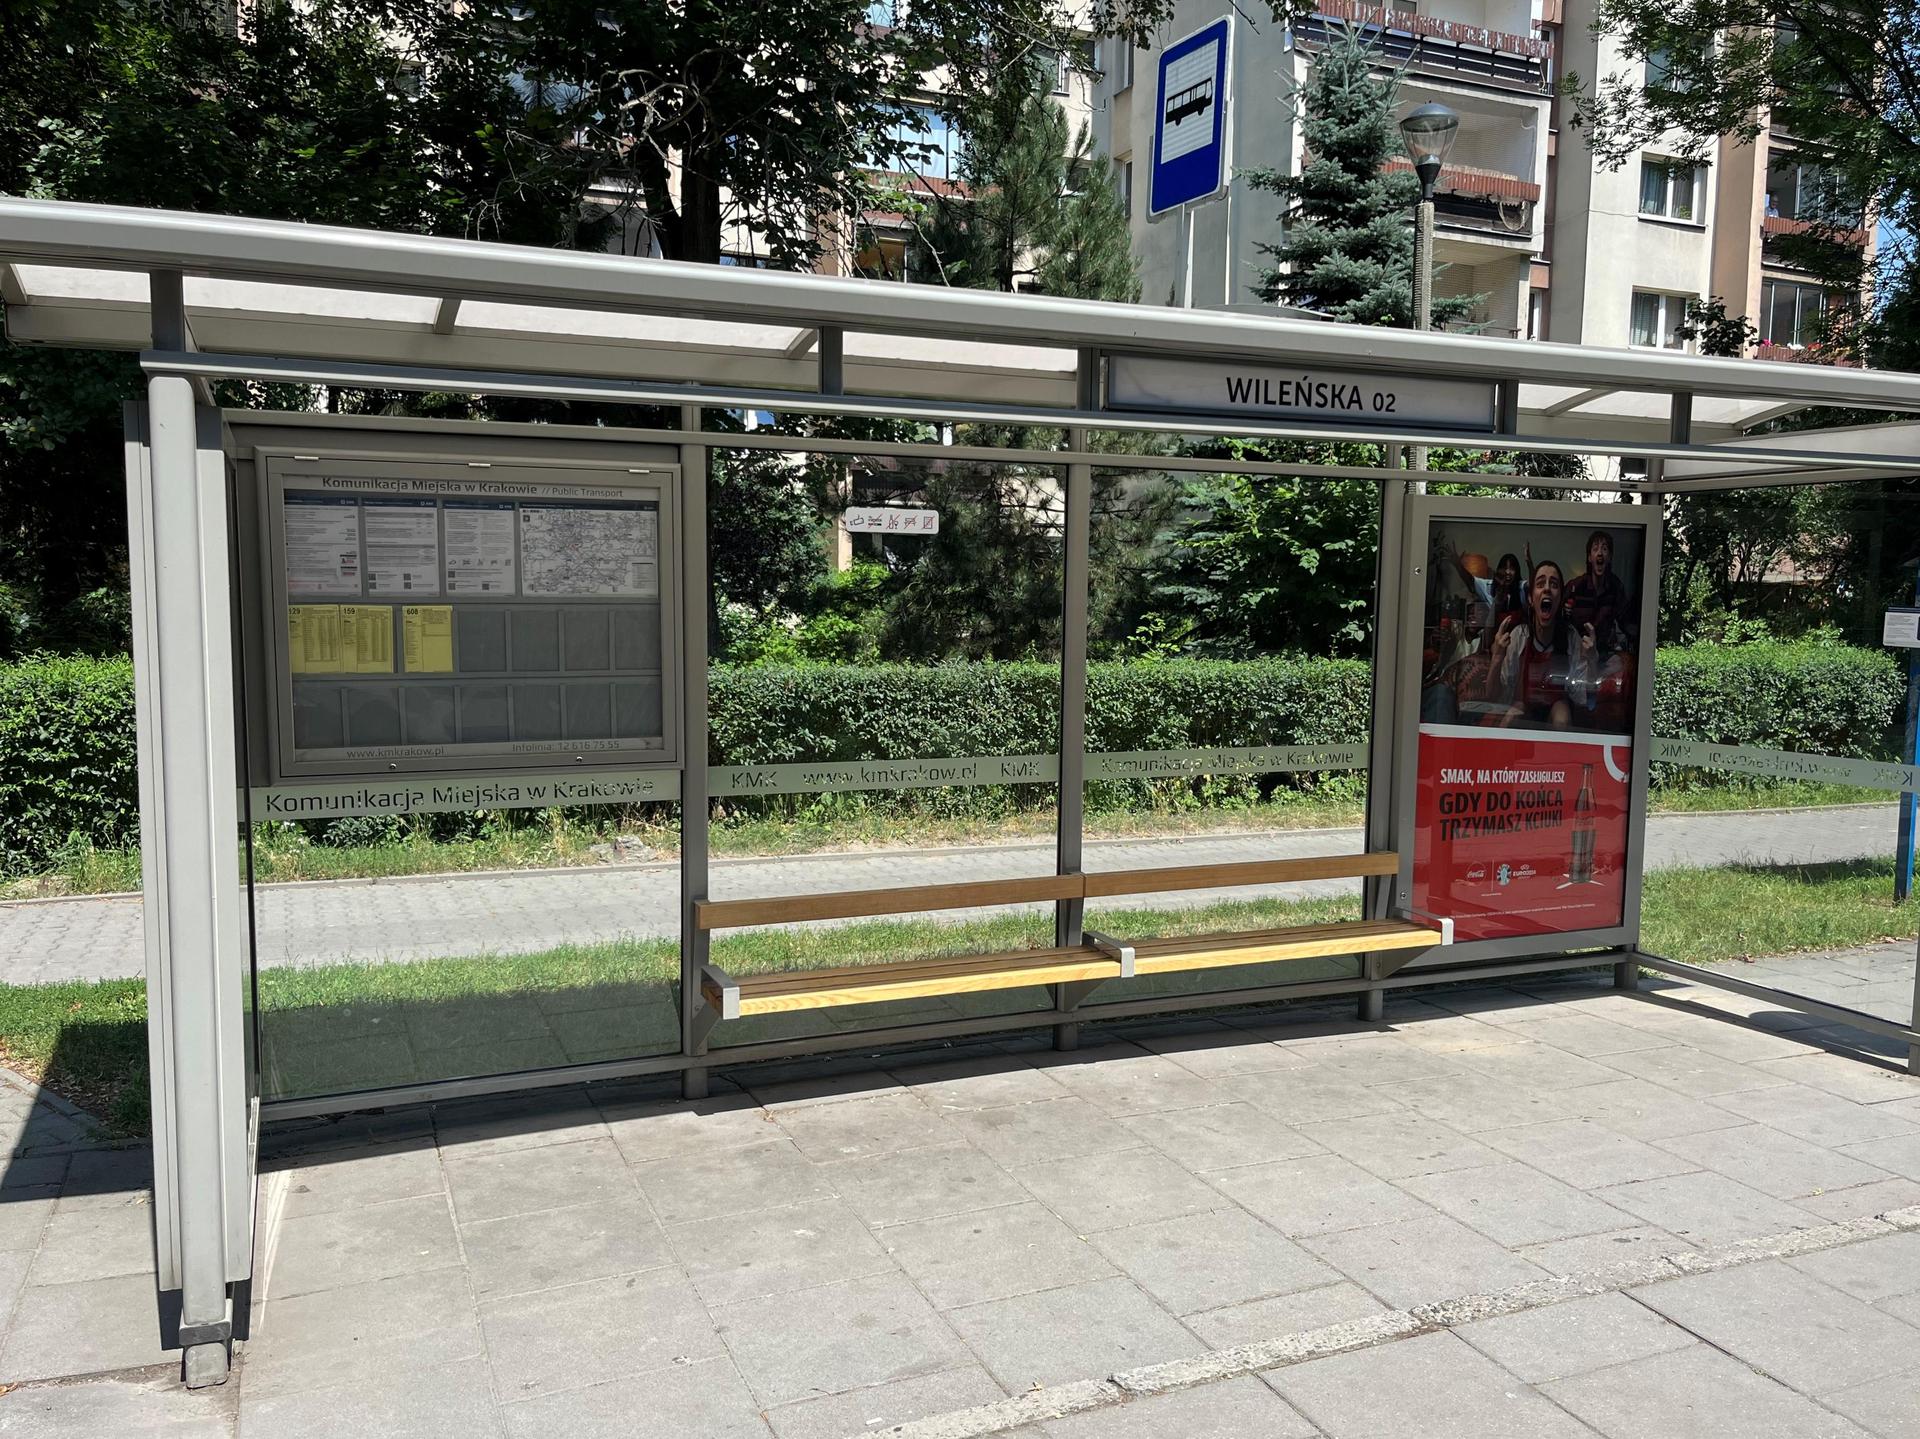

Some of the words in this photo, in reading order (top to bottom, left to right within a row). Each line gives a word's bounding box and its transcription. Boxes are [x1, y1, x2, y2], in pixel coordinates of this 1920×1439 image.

[1226, 375, 1363, 411] WILEŃSKA
[1373, 392, 1396, 412] 02
[322, 477, 409, 492] Komunikacja
[412, 480, 461, 494] Miejska
[479, 483, 537, 494] Krakowie
[552, 487, 578, 496] Public
[581, 488, 624, 498] Transport
[347, 746, 444, 758] www.kmkrakow.pl
[512, 742, 552, 752] Infolinia:
[558, 742, 570, 751] 12
[593, 741, 606, 750] 75
[608, 740, 620, 749] 55
[1287, 750, 1354, 766] Krakowie
[731, 770, 777, 789] KMK
[803, 762, 977, 787] www.kmkrakow.pl
[1001, 760, 1039, 778] KMK
[1440, 768, 1474, 786] SMAK,
[1477, 769, 1491, 784] NA
[1492, 766, 1519, 783] KTÓRY
[1520, 770, 1565, 784] ZASŁUGUJESZ
[266, 788, 424, 812] Komunikacja
[432, 782, 520, 807] Miejska
[528, 784, 547, 799] w
[553, 778, 655, 799] Krakowie
[1439, 791, 1482, 815] GDY
[1487, 791, 1511, 812] DO
[1515, 785, 1563, 810] KOŃCA
[1440, 812, 1522, 841] TRZYMASZ
[1525, 809, 1563, 832] KCIUKI
